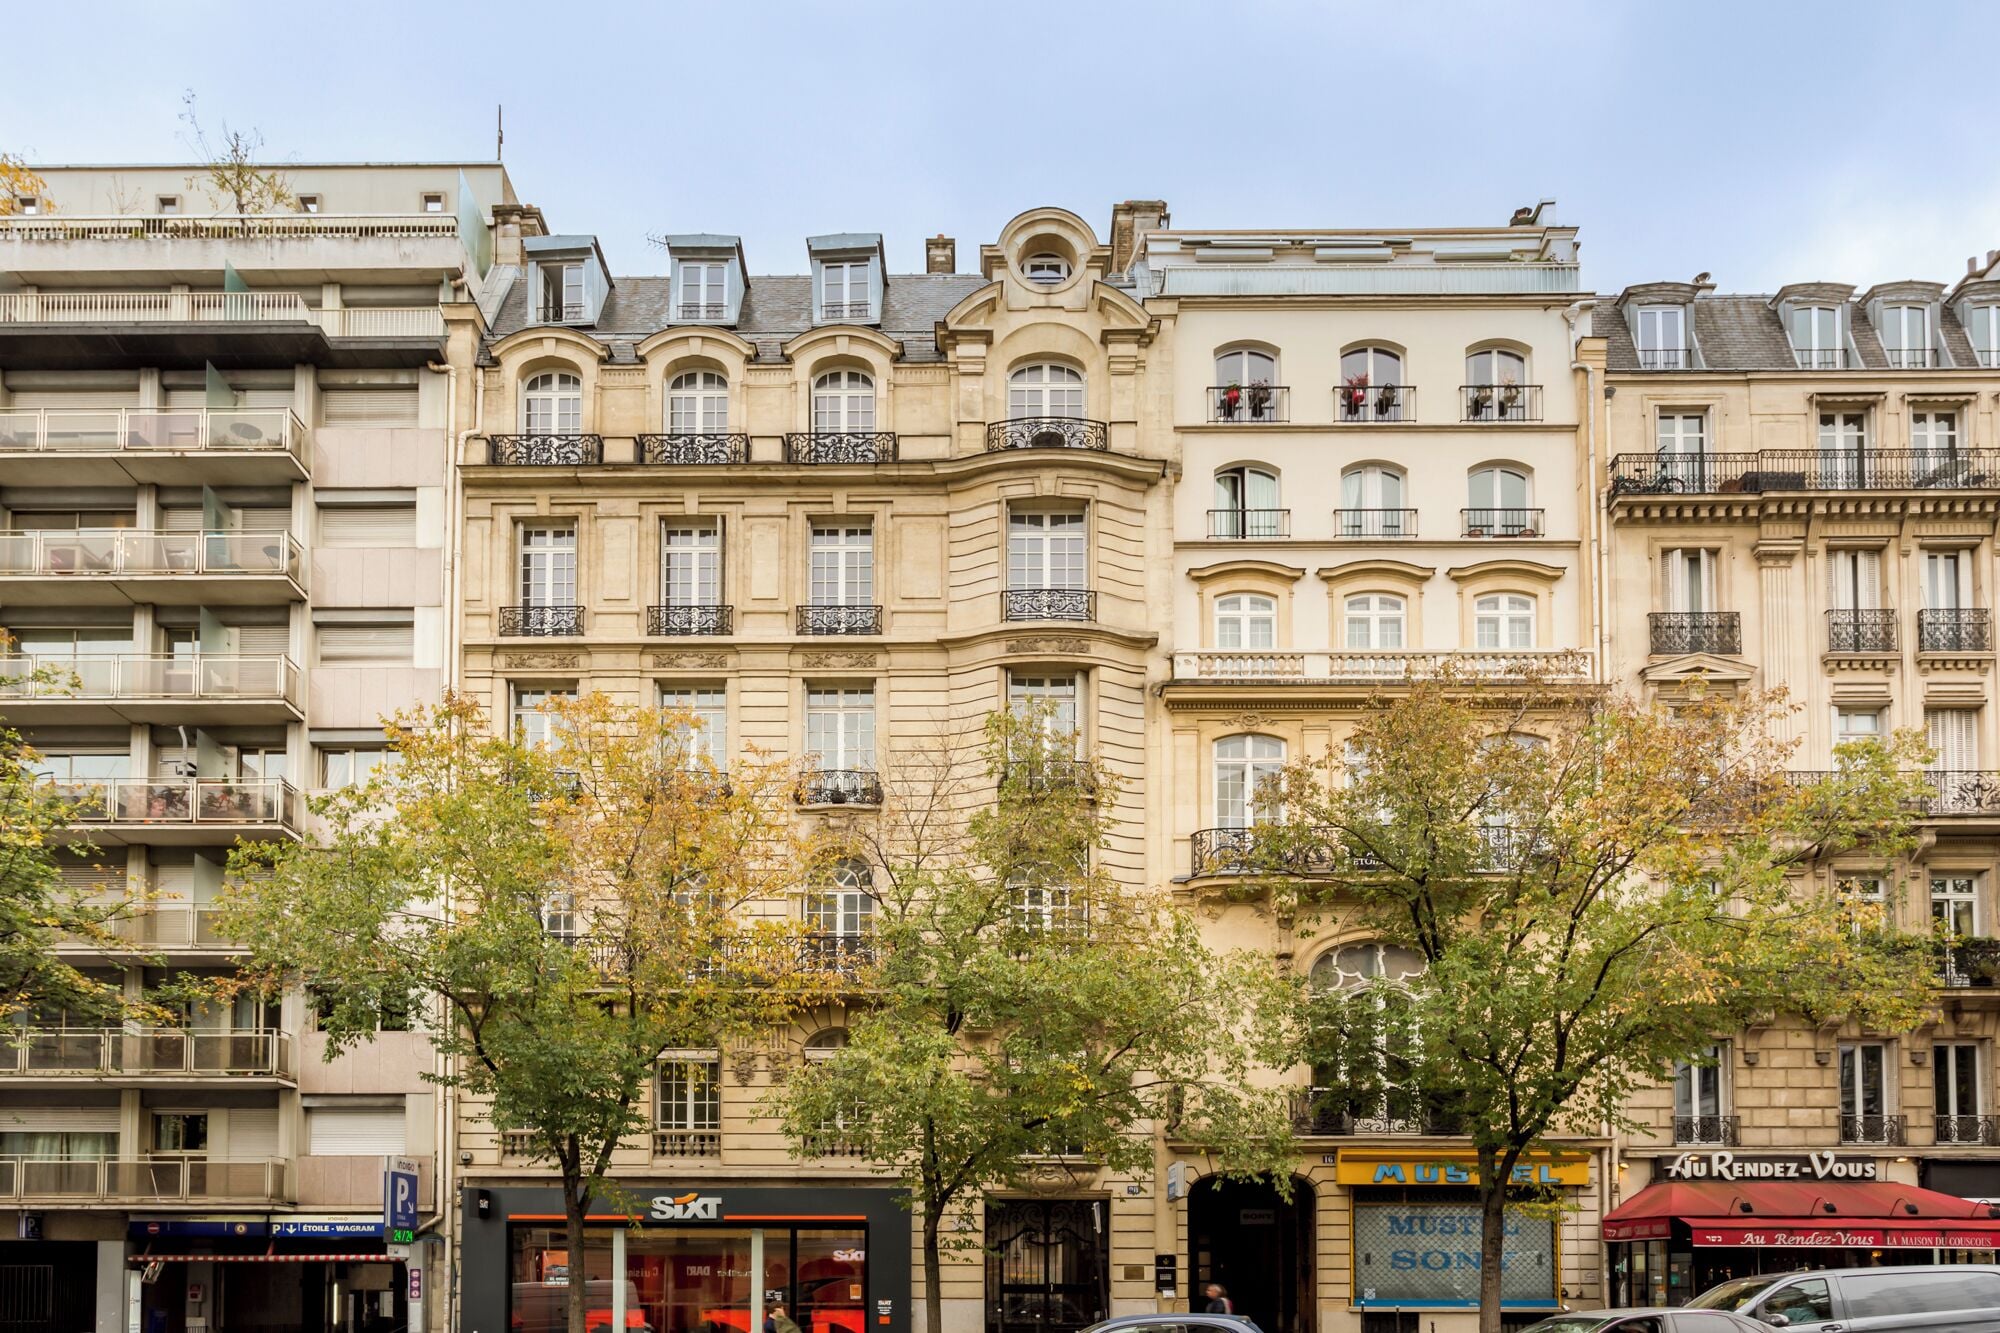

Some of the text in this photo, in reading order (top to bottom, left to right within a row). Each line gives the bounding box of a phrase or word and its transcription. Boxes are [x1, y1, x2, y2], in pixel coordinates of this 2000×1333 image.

[1324, 1155, 1334, 1163] 16
[1373, 1165, 1561, 1183] MUSEL
[396, 1177, 409, 1213] P
[272, 1224, 281, 1235] P
[302, 1223, 330, 1232] ÉTOILE
[336, 1224, 375, 1232] WAGRAM
[1387, 1215, 1520, 1236] MUSTL
[394, 1230, 413, 1242] 24/24
[1740, 1231, 1874, 1246] Au Rendez-Vous
[1887, 1235, 1992, 1247] LA MAISON DU COUSCOUS
